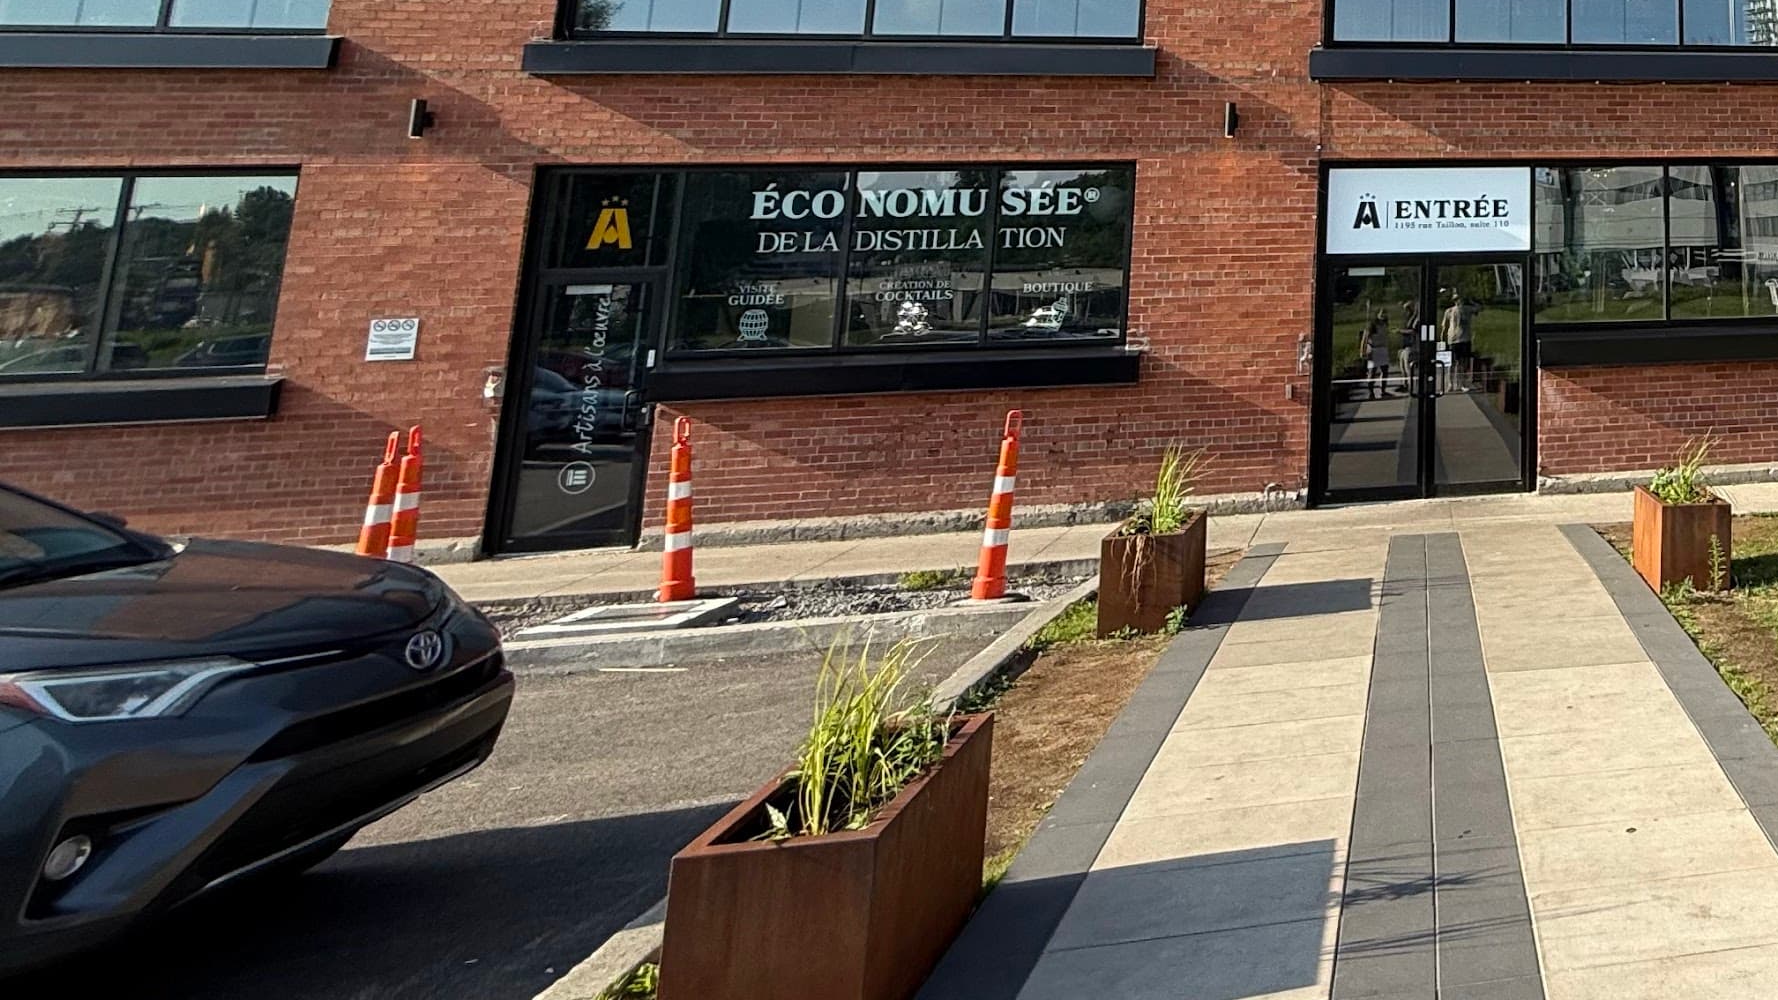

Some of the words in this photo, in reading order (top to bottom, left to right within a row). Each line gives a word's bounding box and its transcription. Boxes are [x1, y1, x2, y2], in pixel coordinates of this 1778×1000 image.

[1394, 194, 1509, 219] ENTRÉE
[1494, 219, 1510, 228] 110
[756, 231, 797, 253] DE
[801, 231, 840, 252] LA
[739, 283, 778, 294] VISITE
[936, 280, 952, 289] DE
[1023, 281, 1094, 294] BOUTIQUE
[875, 289, 954, 302] COCKTAILS
[570, 375, 600, 453] Artisans
